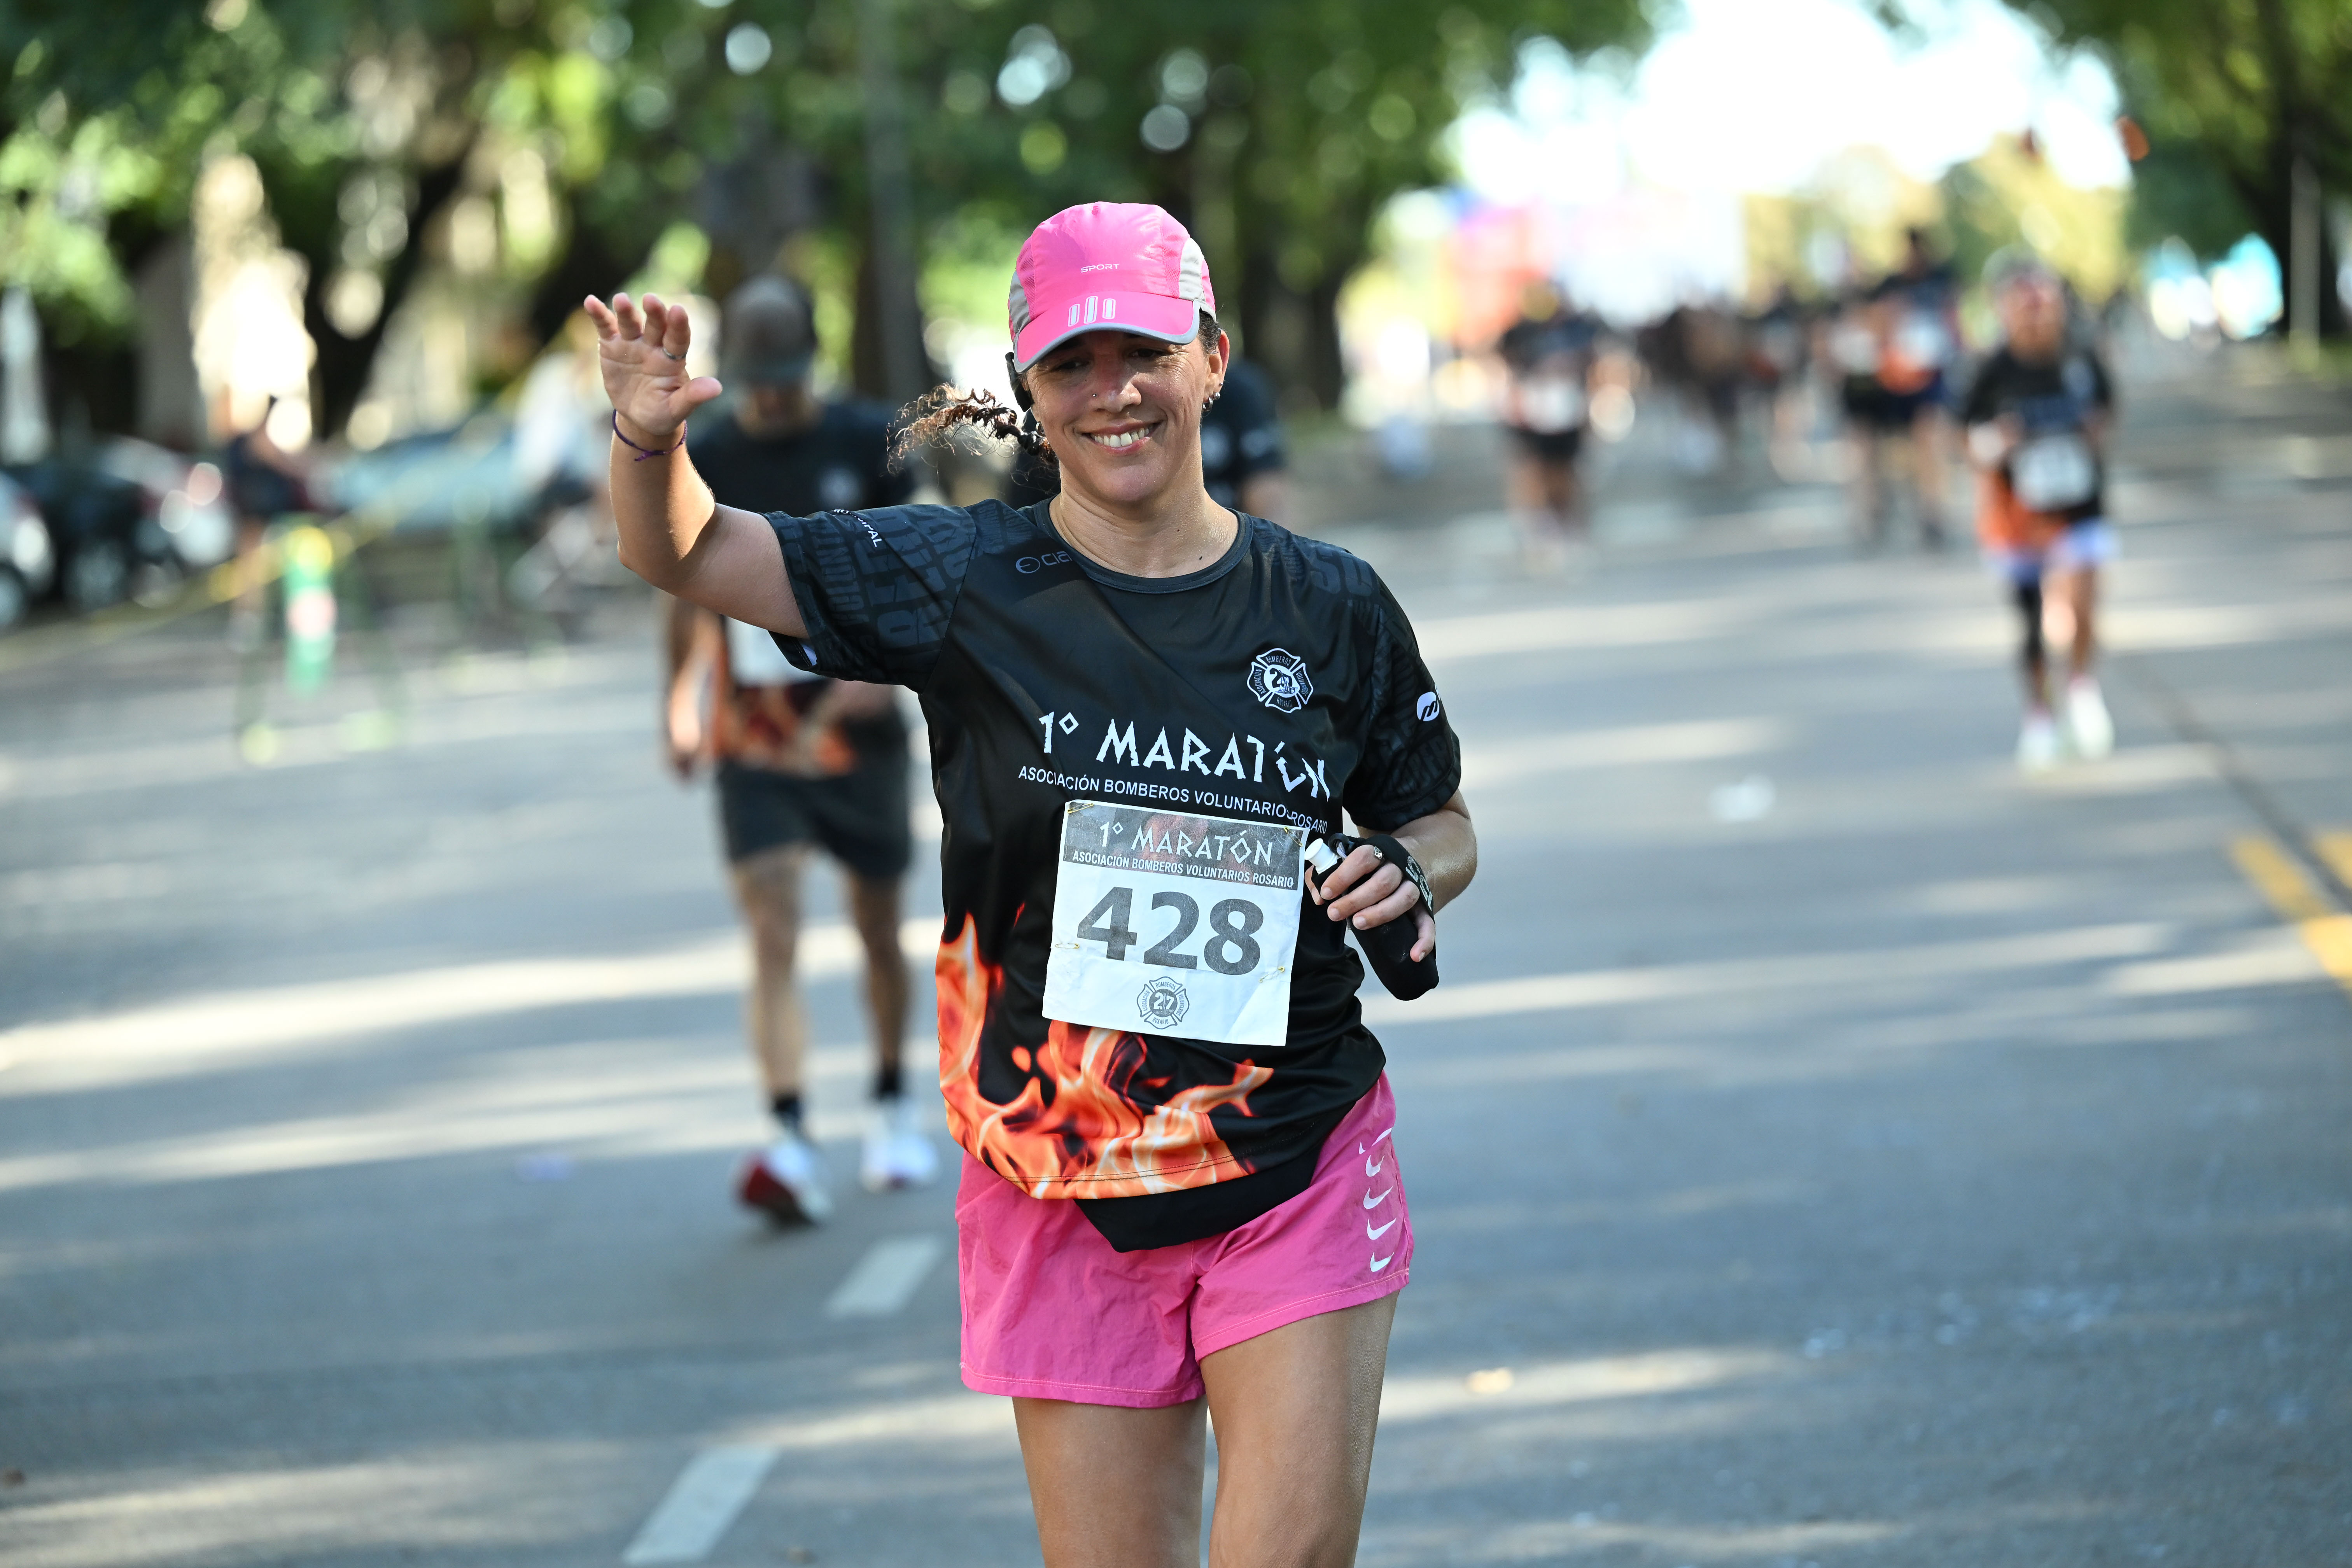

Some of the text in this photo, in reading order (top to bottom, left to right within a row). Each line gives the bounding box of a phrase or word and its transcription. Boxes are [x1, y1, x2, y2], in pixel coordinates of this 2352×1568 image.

[1081, 264, 1120, 273] SPORT
[1265, 655, 1292, 666] BOMBEROS
[1018, 766, 1099, 791] ASOCIACIÓN
[1104, 779, 1189, 802] BOMBEROS
[1291, 811, 1328, 834] ROSARIO
[1130, 824, 1273, 867] MARATÓN
[1072, 850, 1295, 888] ASOCIACIÓN BOMBEROS VOLUNTARIOS ROSARIO
[1076, 886, 1264, 975] 428
[1155, 982, 1176, 990] BOMBEROS
[1153, 992, 1174, 1010] 27
